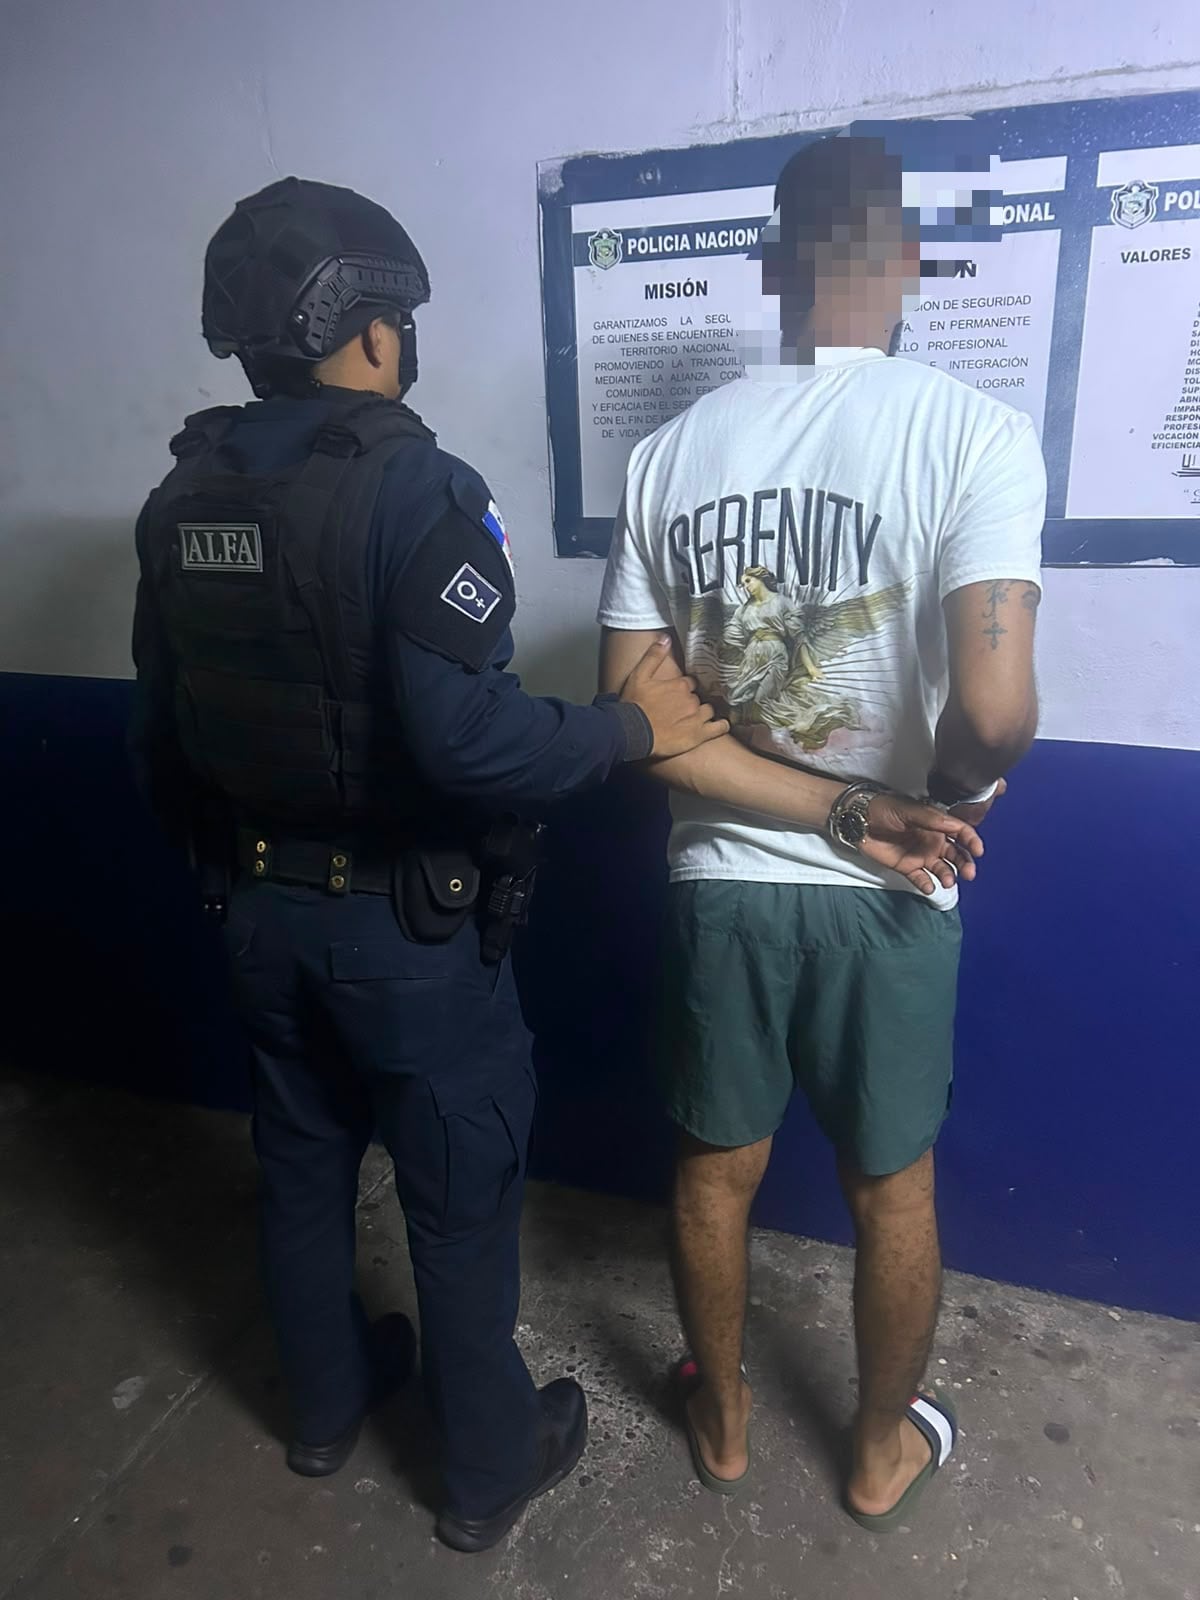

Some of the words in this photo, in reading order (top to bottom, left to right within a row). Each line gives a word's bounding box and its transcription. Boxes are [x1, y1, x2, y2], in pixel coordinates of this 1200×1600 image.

[627, 233, 691, 255] POLICIA
[695, 227, 764, 249] NACION
[1120, 247, 1191, 263] VALORES
[644, 277, 708, 300] MISIÓN
[943, 300, 958, 310] DE
[961, 295, 1032, 310] SEGURIDAD
[593, 317, 668, 331] GARANTIZAMOS
[680, 316, 693, 326] LA
[929, 321, 945, 331] EN
[950, 316, 1031, 330] PERMANENTE
[592, 334, 605, 344] DE
[607, 332, 649, 344] QUIENES
[651, 331, 664, 341] SE
[666, 328, 734, 341] ENCUENTREN
[620, 345, 678, 357] TERRITORIO
[683, 342, 735, 354] NACIONAL,
[927, 338, 1008, 351] PROFESIONAL
[594, 360, 664, 371] PROMOVIENDO
[671, 359, 683, 368] LA
[949, 356, 1028, 370] INTEGRACIÓN
[595, 375, 642, 385] MEDIANTE
[652, 373, 664, 383] LA
[670, 371, 710, 383] ALIANZA
[719, 370, 742, 381] CON
[976, 377, 1025, 389] LOGRAR
[606, 388, 665, 399] COMUNIDAD,
[670, 387, 691, 396] CON
[592, 403, 599, 412] Y
[600, 401, 642, 412] EFICACIA
[643, 401, 656, 410] EN
[658, 400, 670, 409] EL
[593, 415, 613, 425] CON
[615, 415, 626, 424] EL
[628, 415, 643, 424] FIN
[645, 414, 658, 423] DE
[601, 429, 614, 438] DE
[619, 428, 640, 438] VIDA
[188, 531, 256, 563] ALFA
[669, 487, 882, 595] SERENITY
